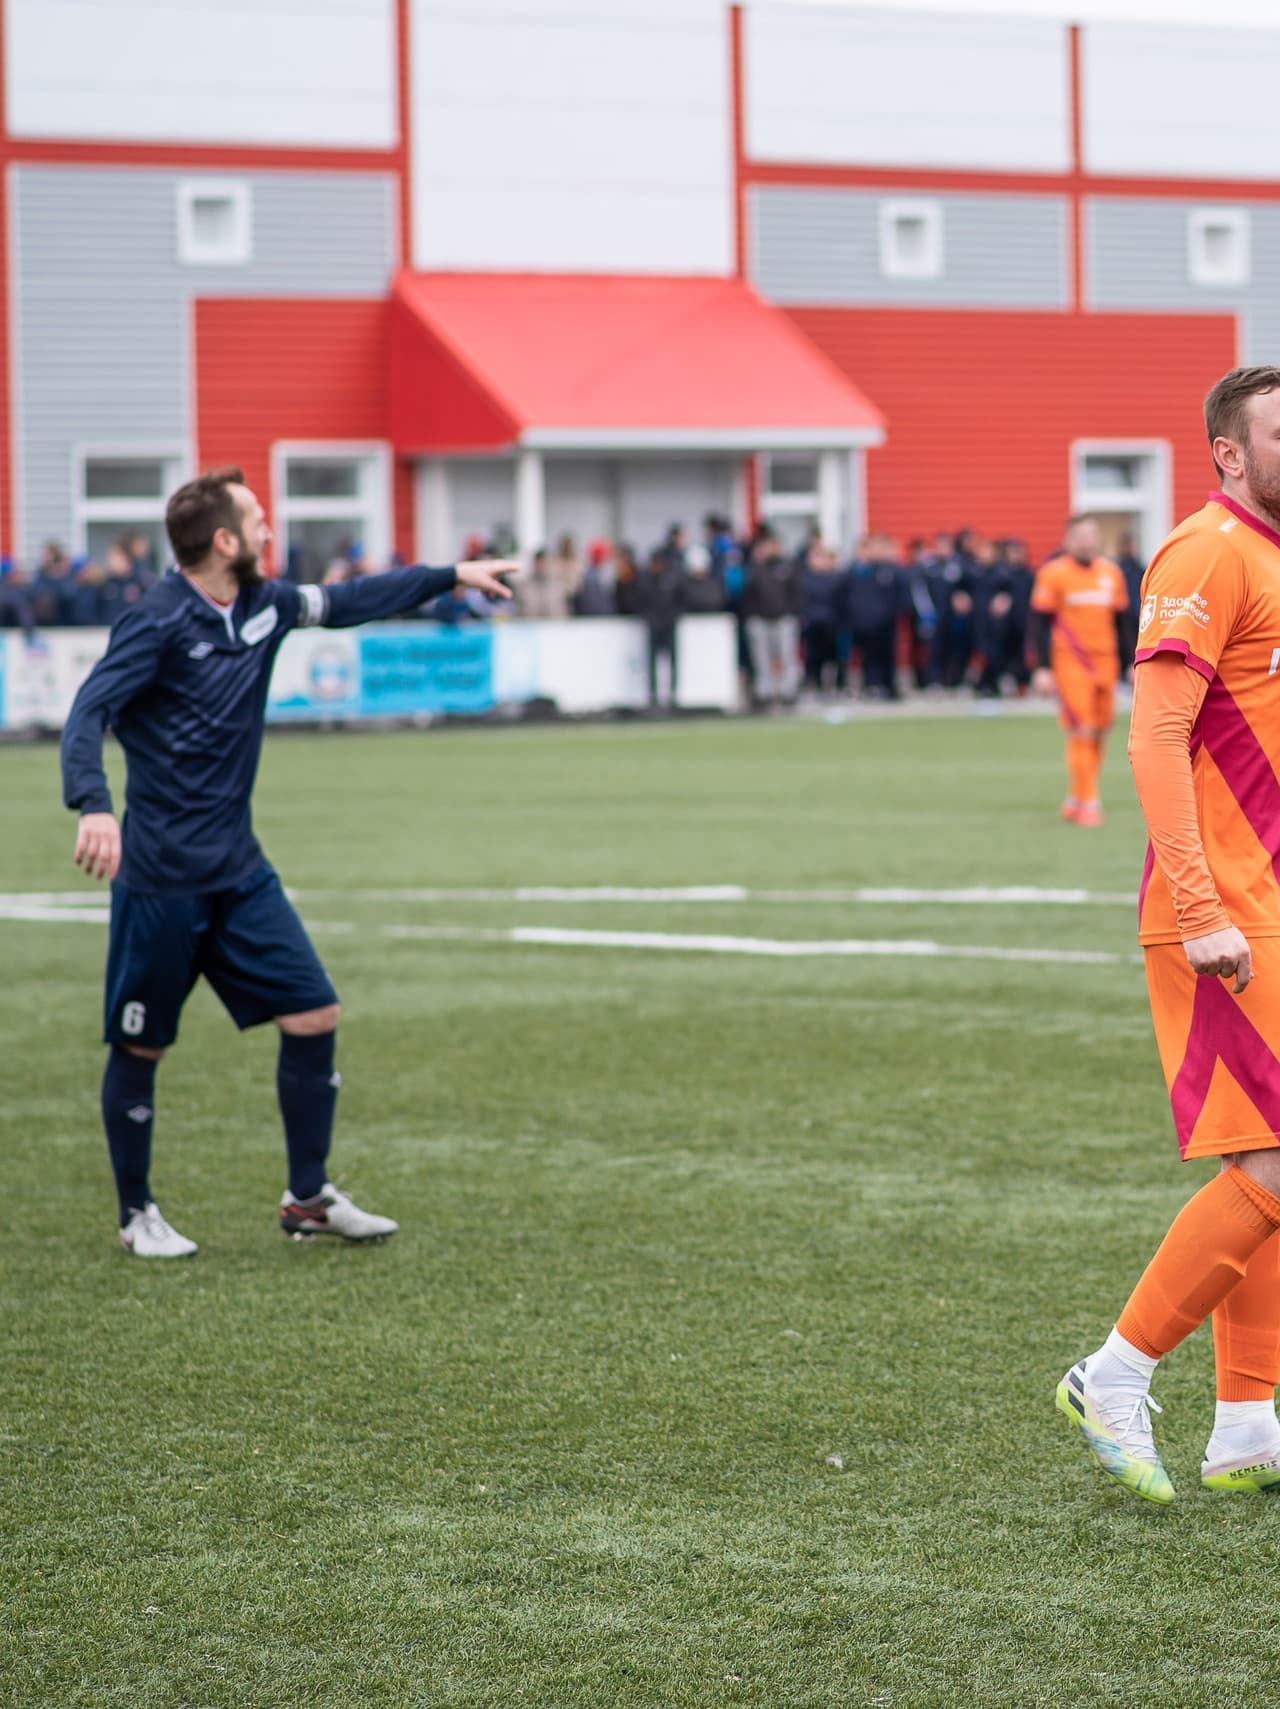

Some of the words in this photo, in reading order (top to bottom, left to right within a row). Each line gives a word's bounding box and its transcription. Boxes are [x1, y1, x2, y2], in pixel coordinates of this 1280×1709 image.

[1161, 593, 1208, 608] Здовое
[1160, 604, 1210, 623] покние
[122, 1001, 146, 1036] 6
[1230, 1460, 1278, 1479] NEMESIS
